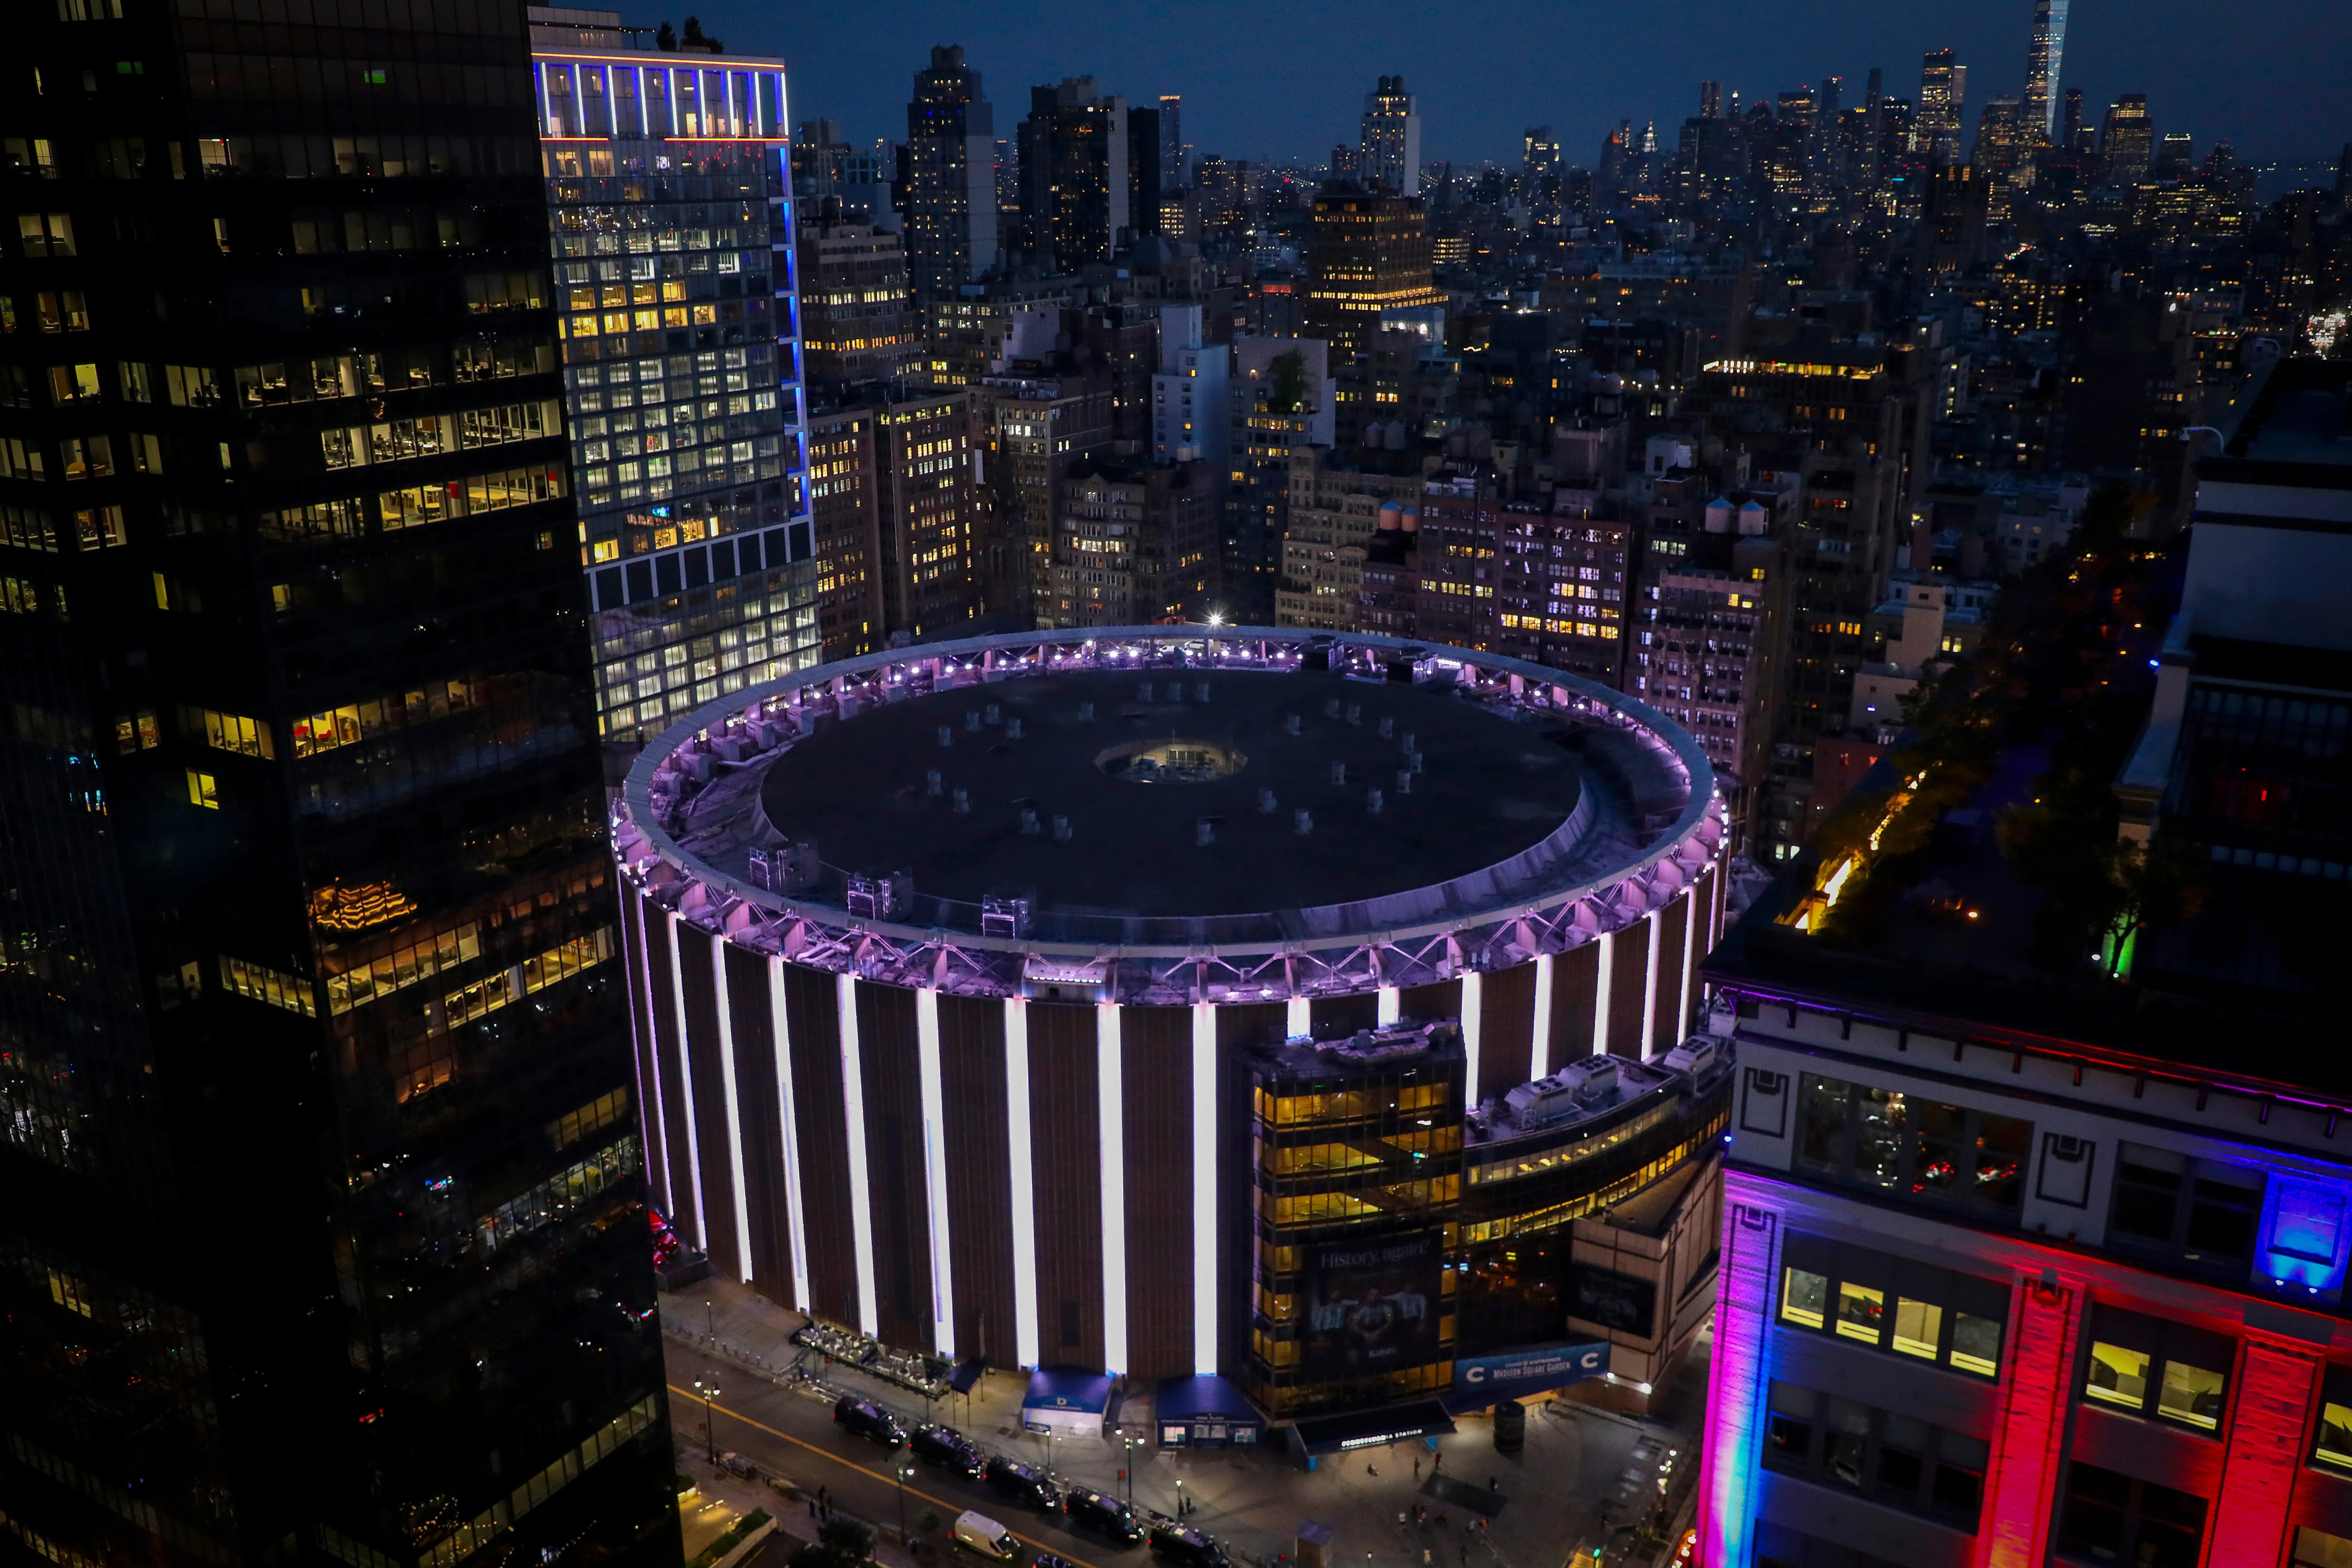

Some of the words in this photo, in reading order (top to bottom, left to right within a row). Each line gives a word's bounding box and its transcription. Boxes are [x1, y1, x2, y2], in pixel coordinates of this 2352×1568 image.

[1382, 1238, 1430, 1261] again?
[1581, 1352, 1599, 1368] C
[1466, 1366, 1485, 1382] C
